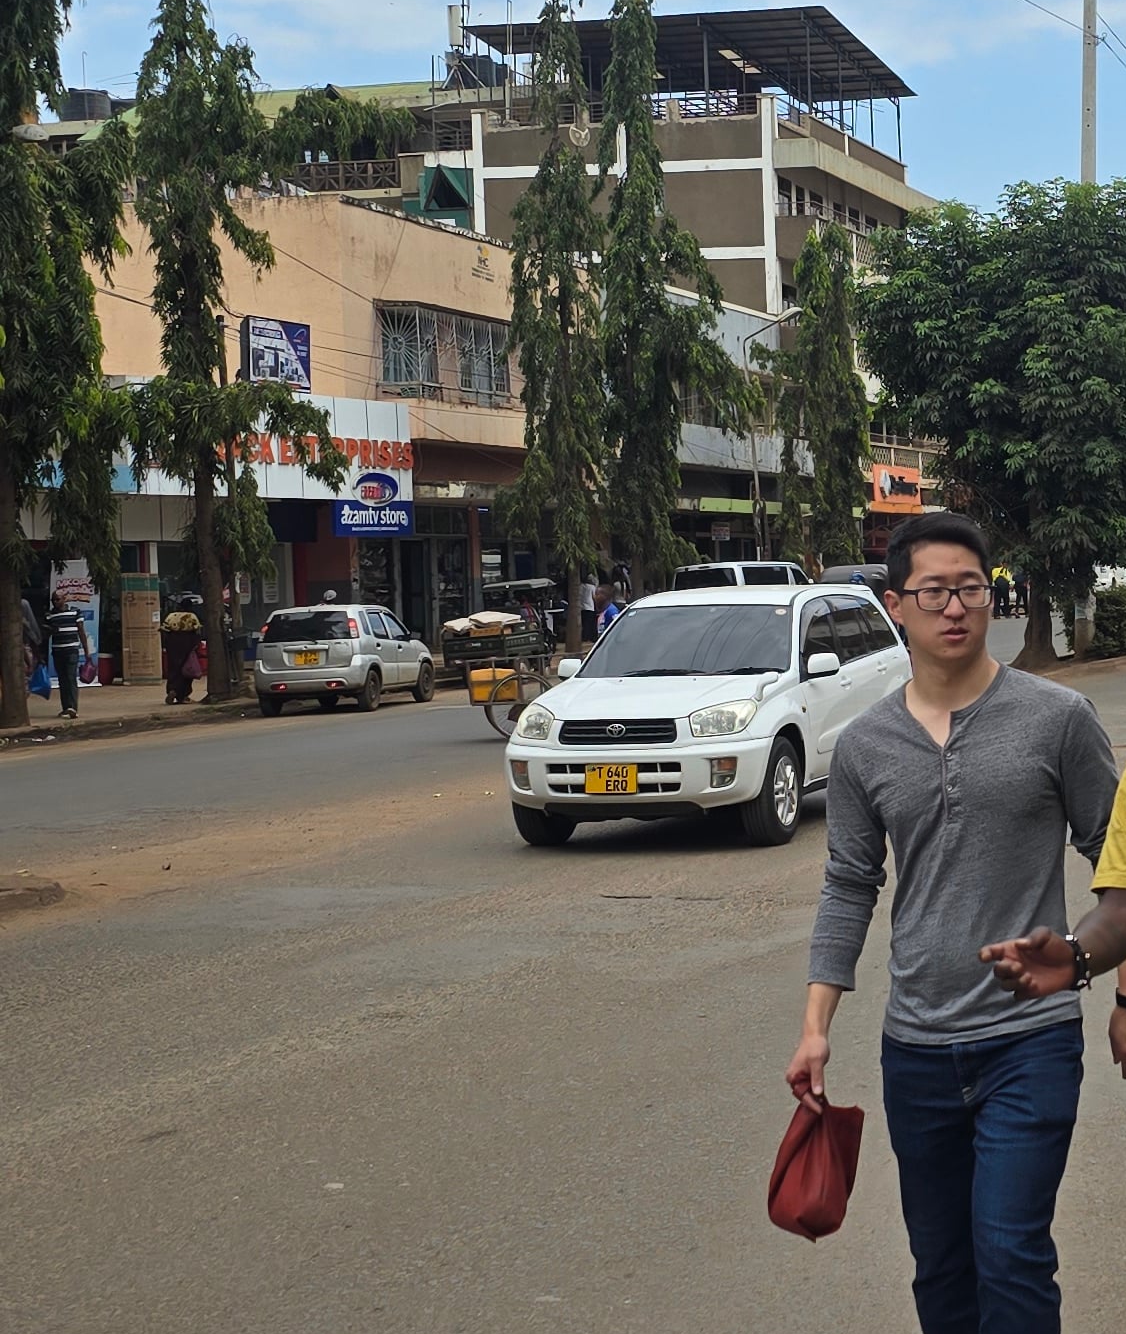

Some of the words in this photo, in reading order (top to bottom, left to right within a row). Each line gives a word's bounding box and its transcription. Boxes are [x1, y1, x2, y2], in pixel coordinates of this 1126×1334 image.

[340, 504, 380, 525] azamtv
[597, 766, 604, 779] T
[607, 767, 628, 778] 640
[605, 780, 628, 791] ERQ
